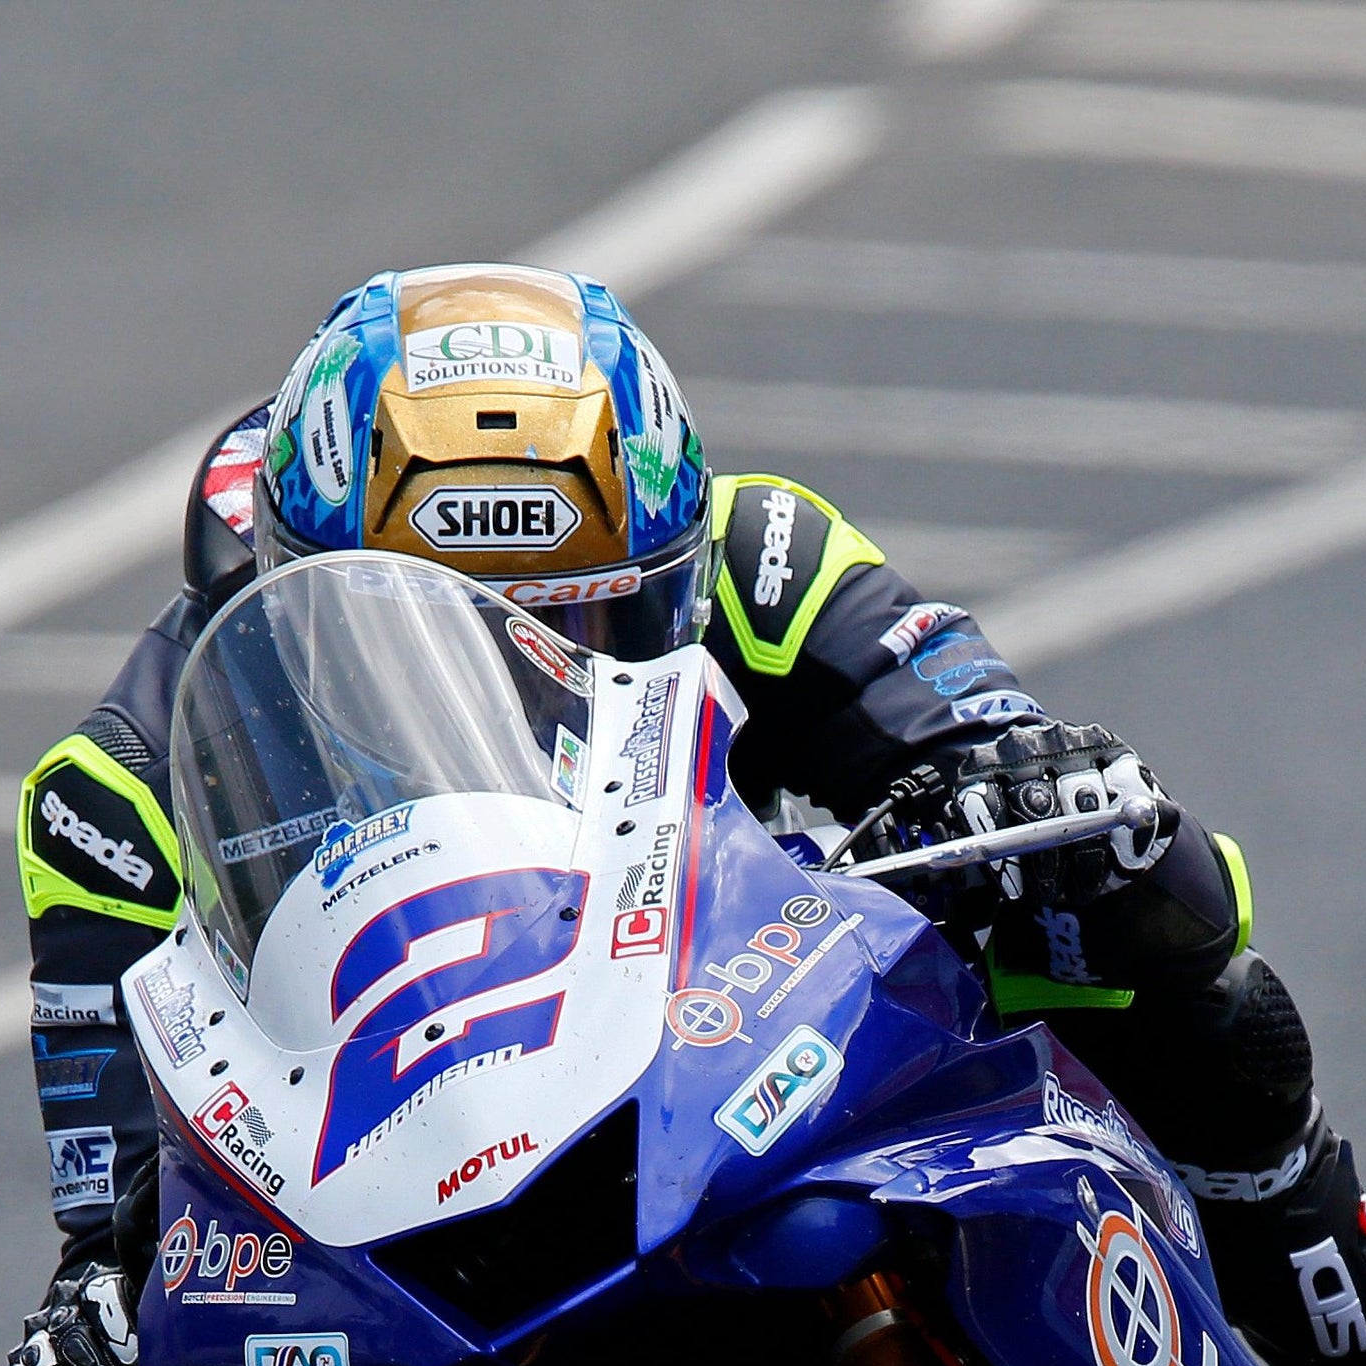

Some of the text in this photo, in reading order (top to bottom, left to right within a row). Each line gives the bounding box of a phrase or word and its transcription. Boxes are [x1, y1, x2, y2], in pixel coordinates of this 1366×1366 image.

[414, 362, 574, 386] SOLUTIONS LTD
[439, 323, 555, 364] CDI
[438, 500, 555, 537] SHOEI
[505, 574, 638, 605] Care
[40, 790, 155, 891] spada
[317, 809, 409, 872] CAFFREY
[323, 848, 419, 911] METZELER
[614, 823, 678, 959] IC Racing
[705, 895, 831, 994] bpe
[312, 867, 590, 1188] 2
[192, 1081, 286, 1196] IC Racing
[437, 1131, 539, 1206] MOTUL
[197, 1220, 293, 1291] bpe
[206, 1293, 244, 1303] PRECISION
